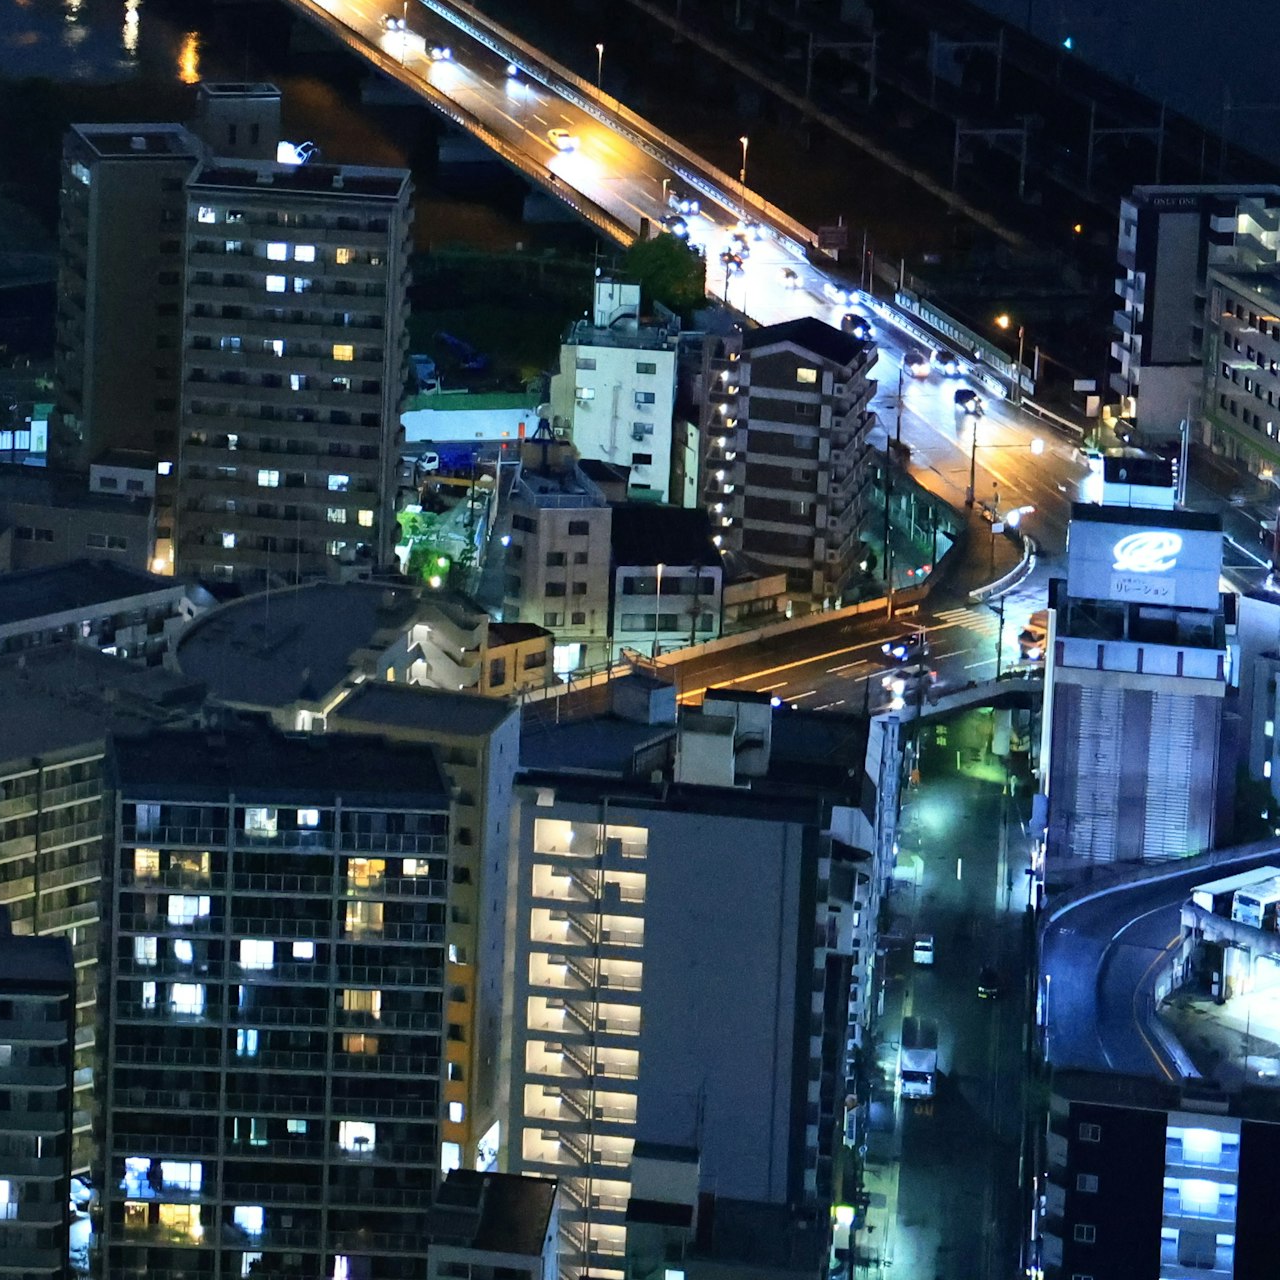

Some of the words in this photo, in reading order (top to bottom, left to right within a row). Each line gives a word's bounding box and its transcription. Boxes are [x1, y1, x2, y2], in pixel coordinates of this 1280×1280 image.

[1116, 581, 1169, 596] リレーション
